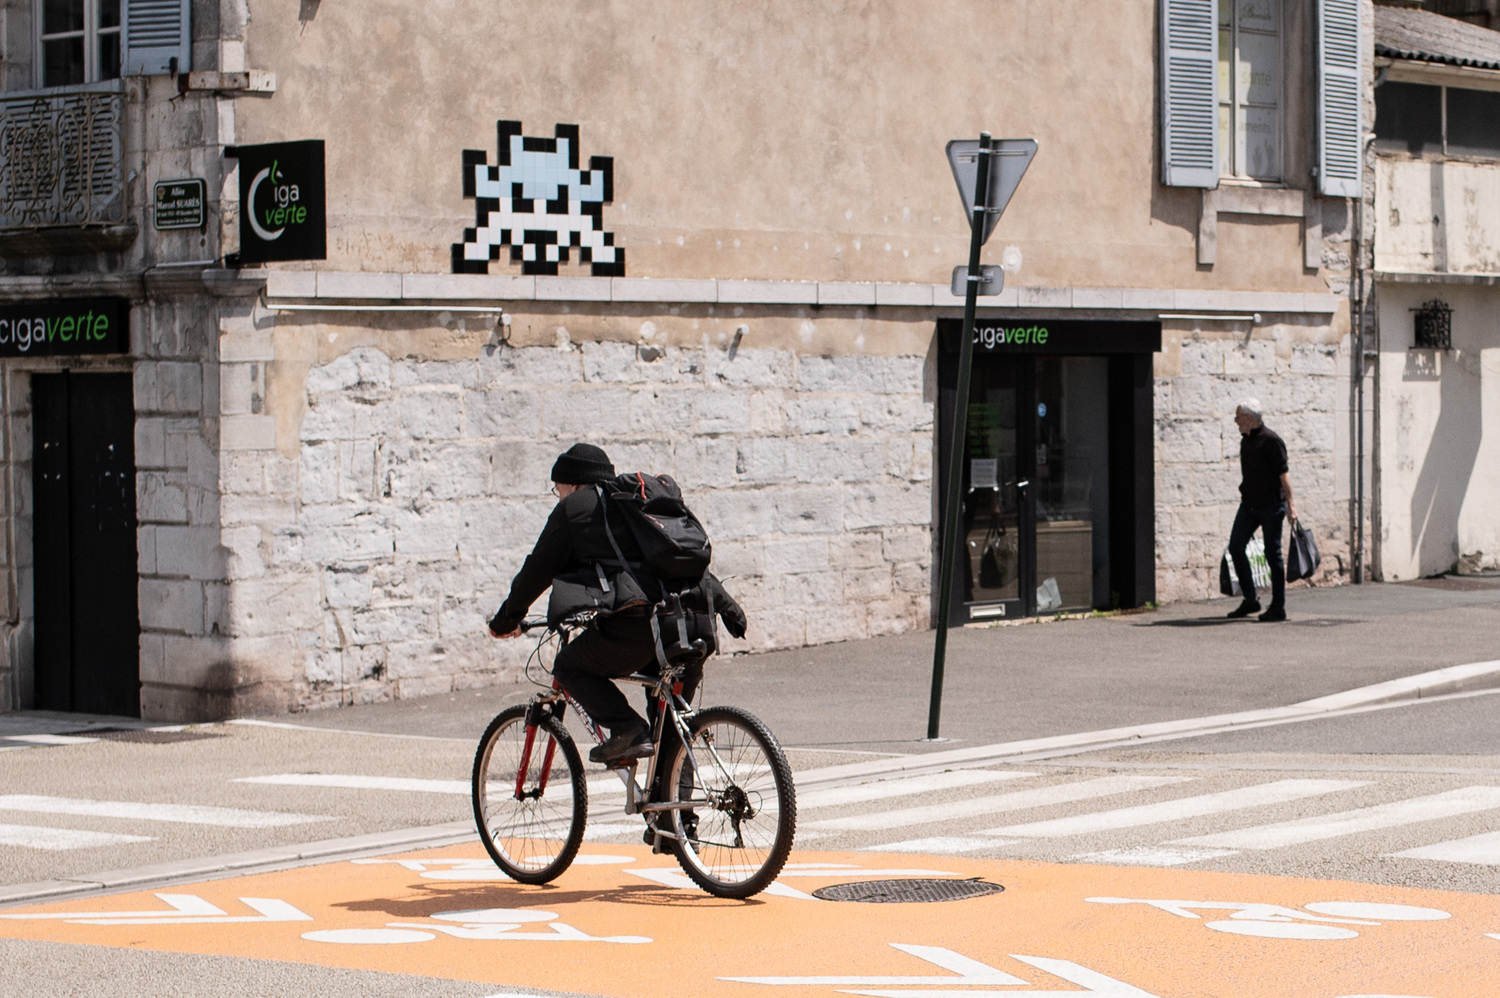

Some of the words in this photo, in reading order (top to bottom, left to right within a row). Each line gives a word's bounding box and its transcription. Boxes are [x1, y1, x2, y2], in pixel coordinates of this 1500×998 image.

[157, 200, 175, 209] Marcel
[265, 204, 307, 225] verte
[0, 309, 109, 352] cigaverte
[972, 325, 1049, 349] cigaverte
